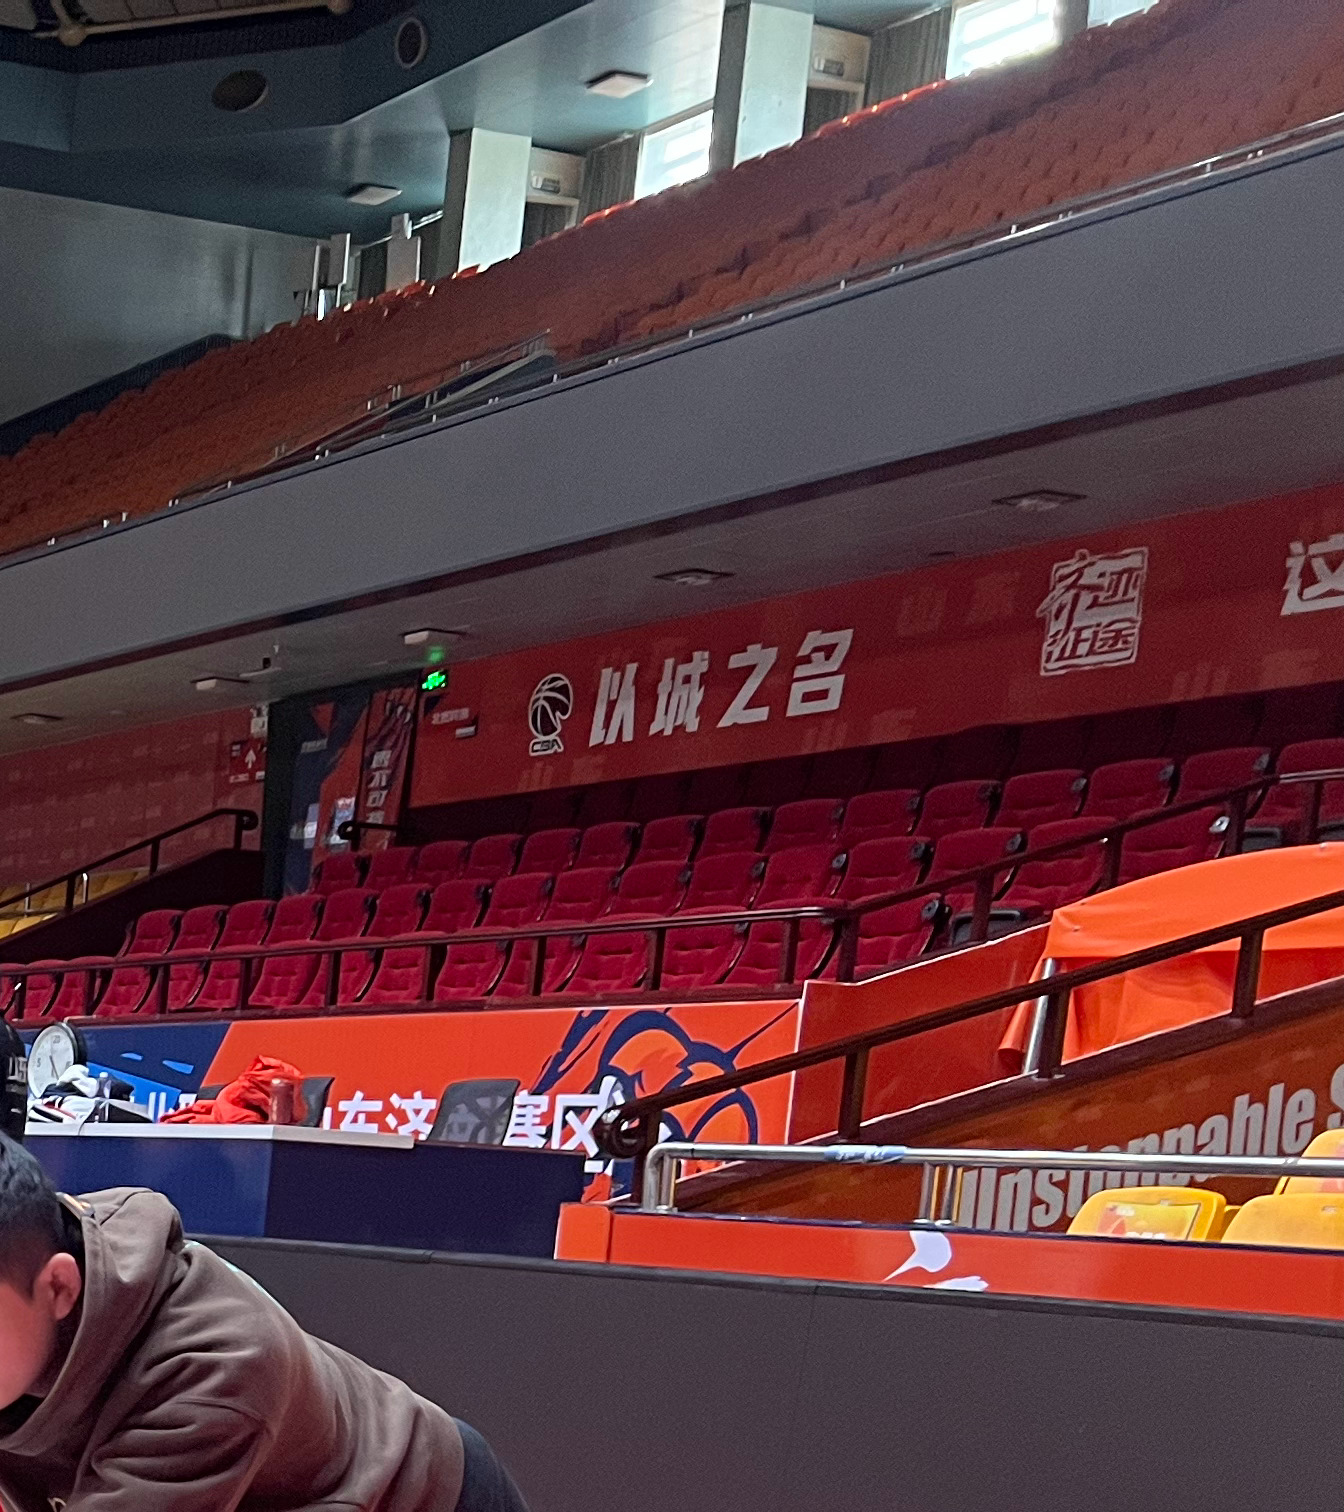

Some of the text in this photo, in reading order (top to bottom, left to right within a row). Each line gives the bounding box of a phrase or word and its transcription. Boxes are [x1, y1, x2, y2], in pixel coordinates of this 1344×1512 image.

[588, 628, 855, 748] 以城之名
[530, 738, 563, 755] CBA
